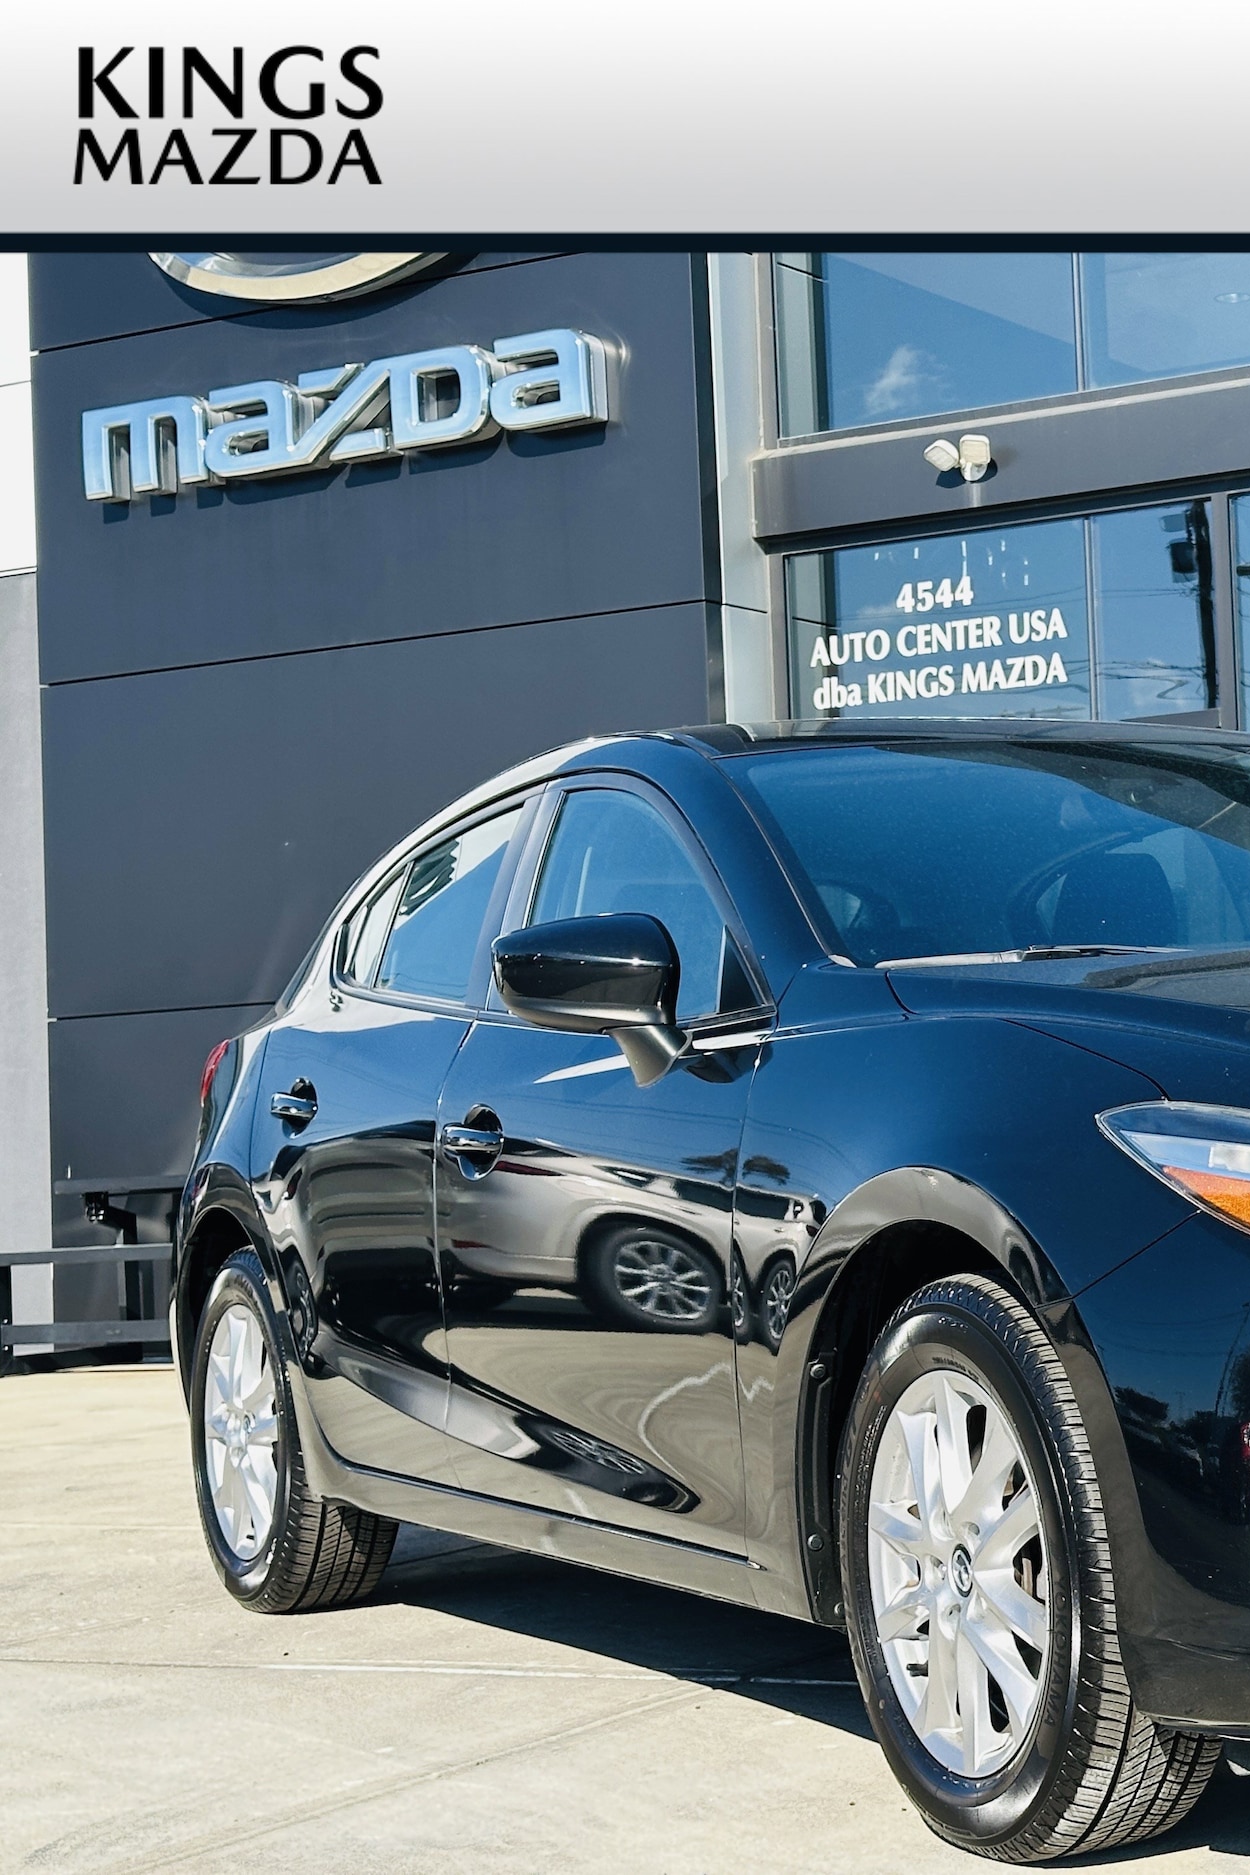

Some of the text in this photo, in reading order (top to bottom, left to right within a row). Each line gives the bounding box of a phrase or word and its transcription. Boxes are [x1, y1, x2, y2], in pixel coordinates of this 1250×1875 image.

[896, 575, 974, 614] 4544
[810, 607, 1068, 668] AUTO CENTER USA
[813, 652, 1068, 711] dba KINGS MAZDA
[1044, 1577, 1067, 1727] YOKOHAMA
